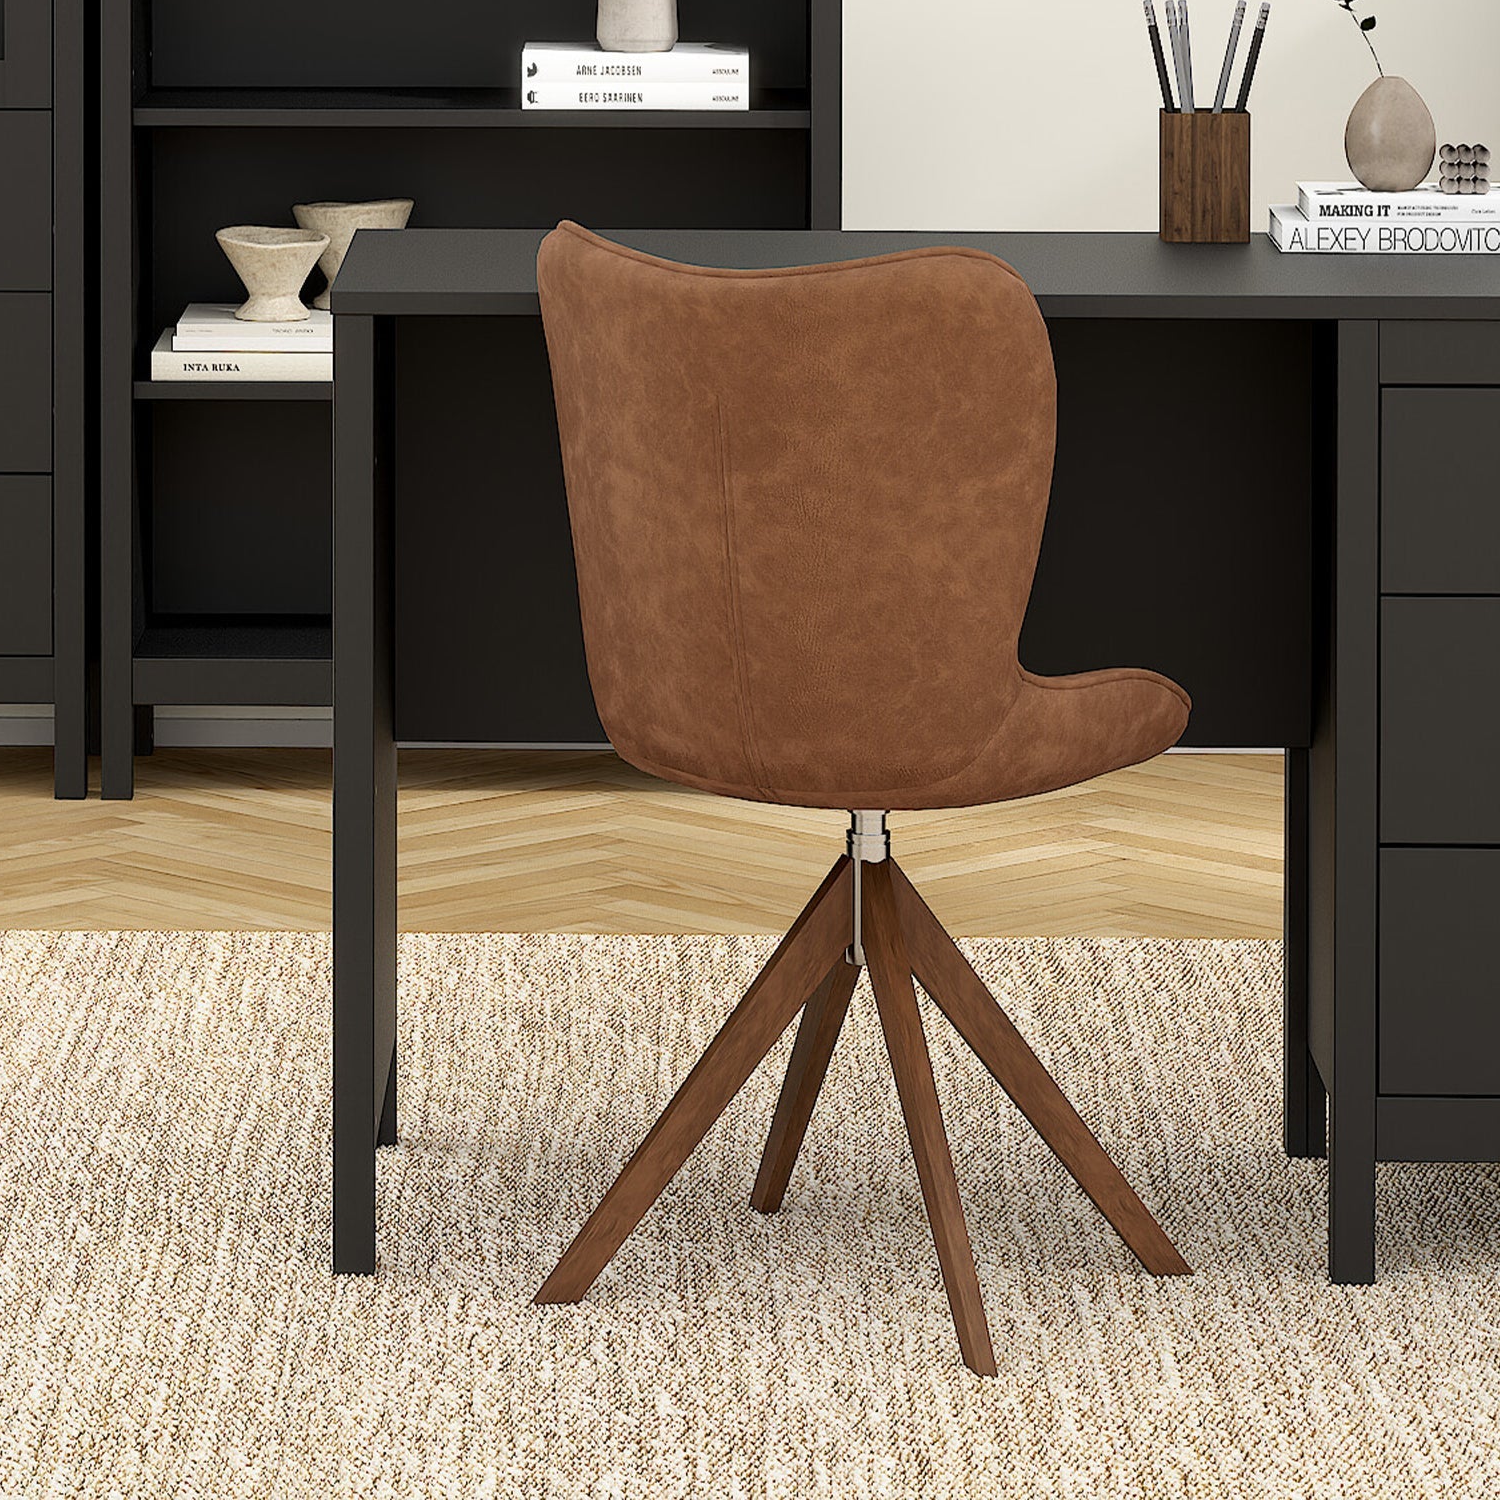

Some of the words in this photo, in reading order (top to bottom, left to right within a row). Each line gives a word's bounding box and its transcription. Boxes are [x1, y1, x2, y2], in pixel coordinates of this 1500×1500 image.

[576, 65, 598, 76] ARNE
[600, 65, 642, 76] JACOBSEN
[602, 92, 643, 103] SAARINEN
[1318, 204, 1374, 217] MAKING
[1376, 204, 1391, 217] IT
[1289, 227, 1371, 251] ALEXEY
[1378, 227, 1500, 252] BRODOVITC
[183, 363, 209, 372] INTA
[211, 363, 241, 372] RUKA
